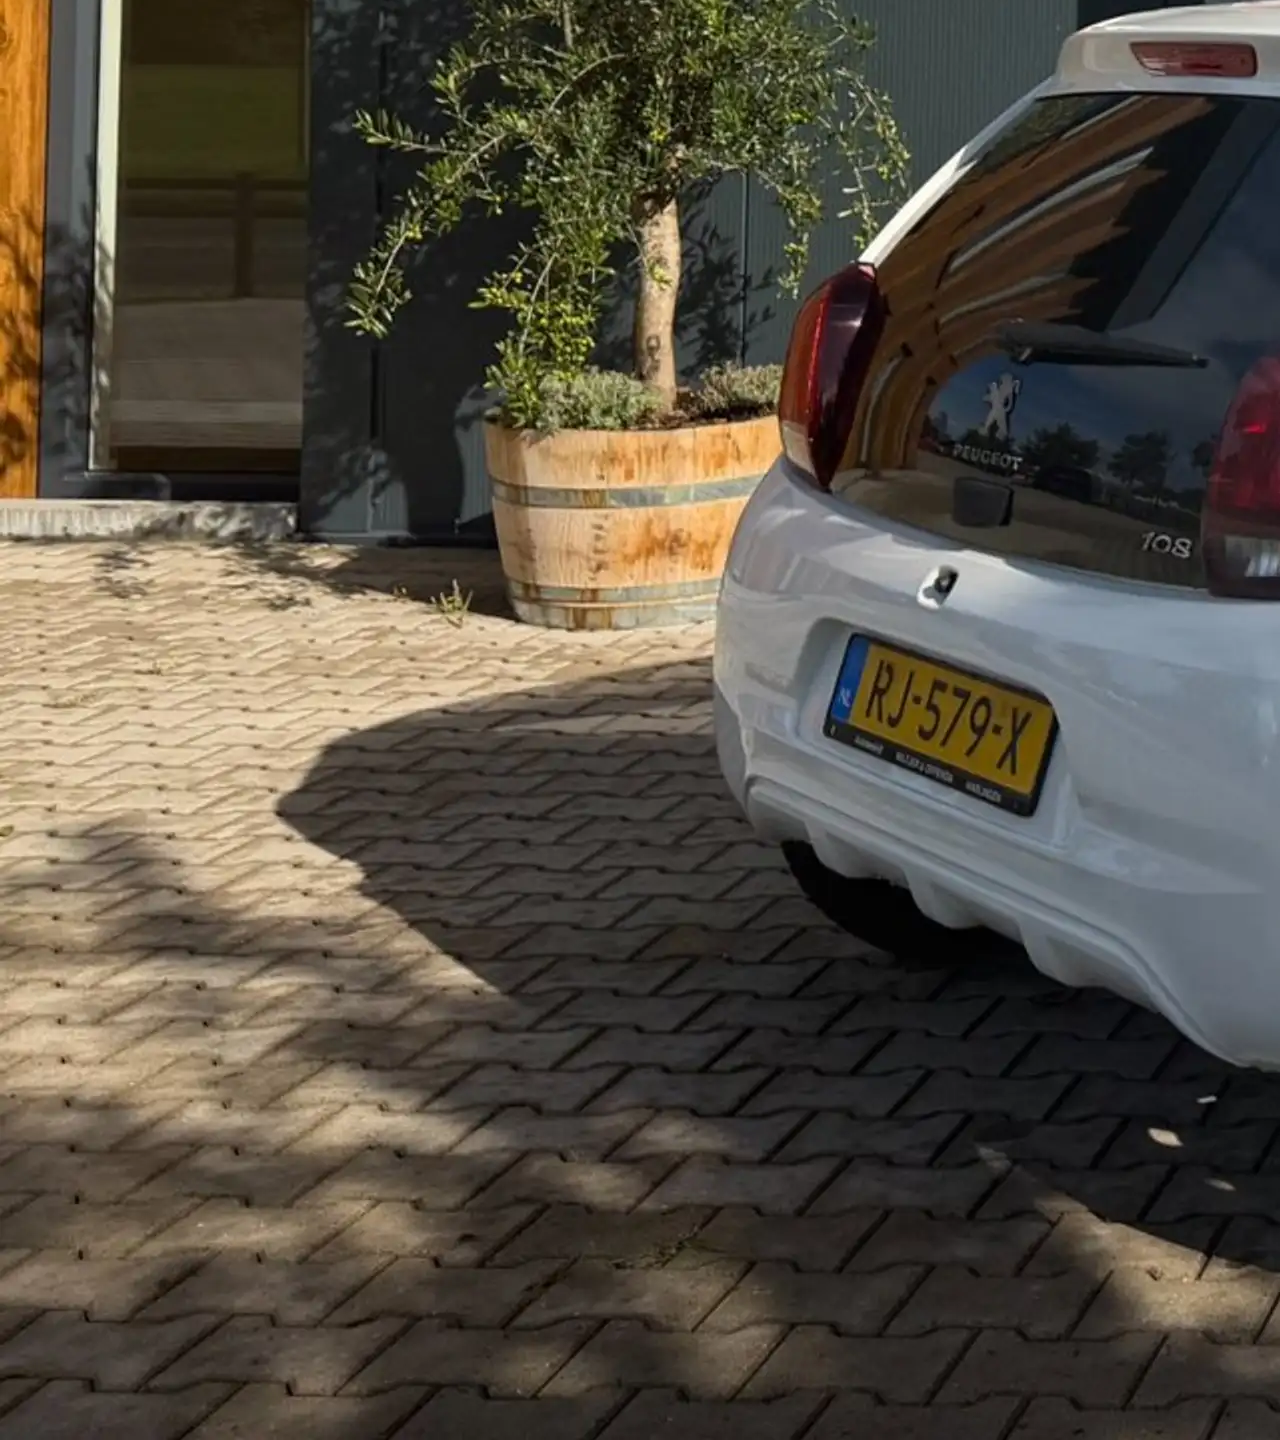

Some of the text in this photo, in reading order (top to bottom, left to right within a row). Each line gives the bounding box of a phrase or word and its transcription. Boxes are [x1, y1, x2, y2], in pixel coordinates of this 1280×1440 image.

[952, 443, 1024, 471] PEUGEOT
[1141, 531, 1192, 559] 108
[865, 659, 1032, 776] RJ-579-X
